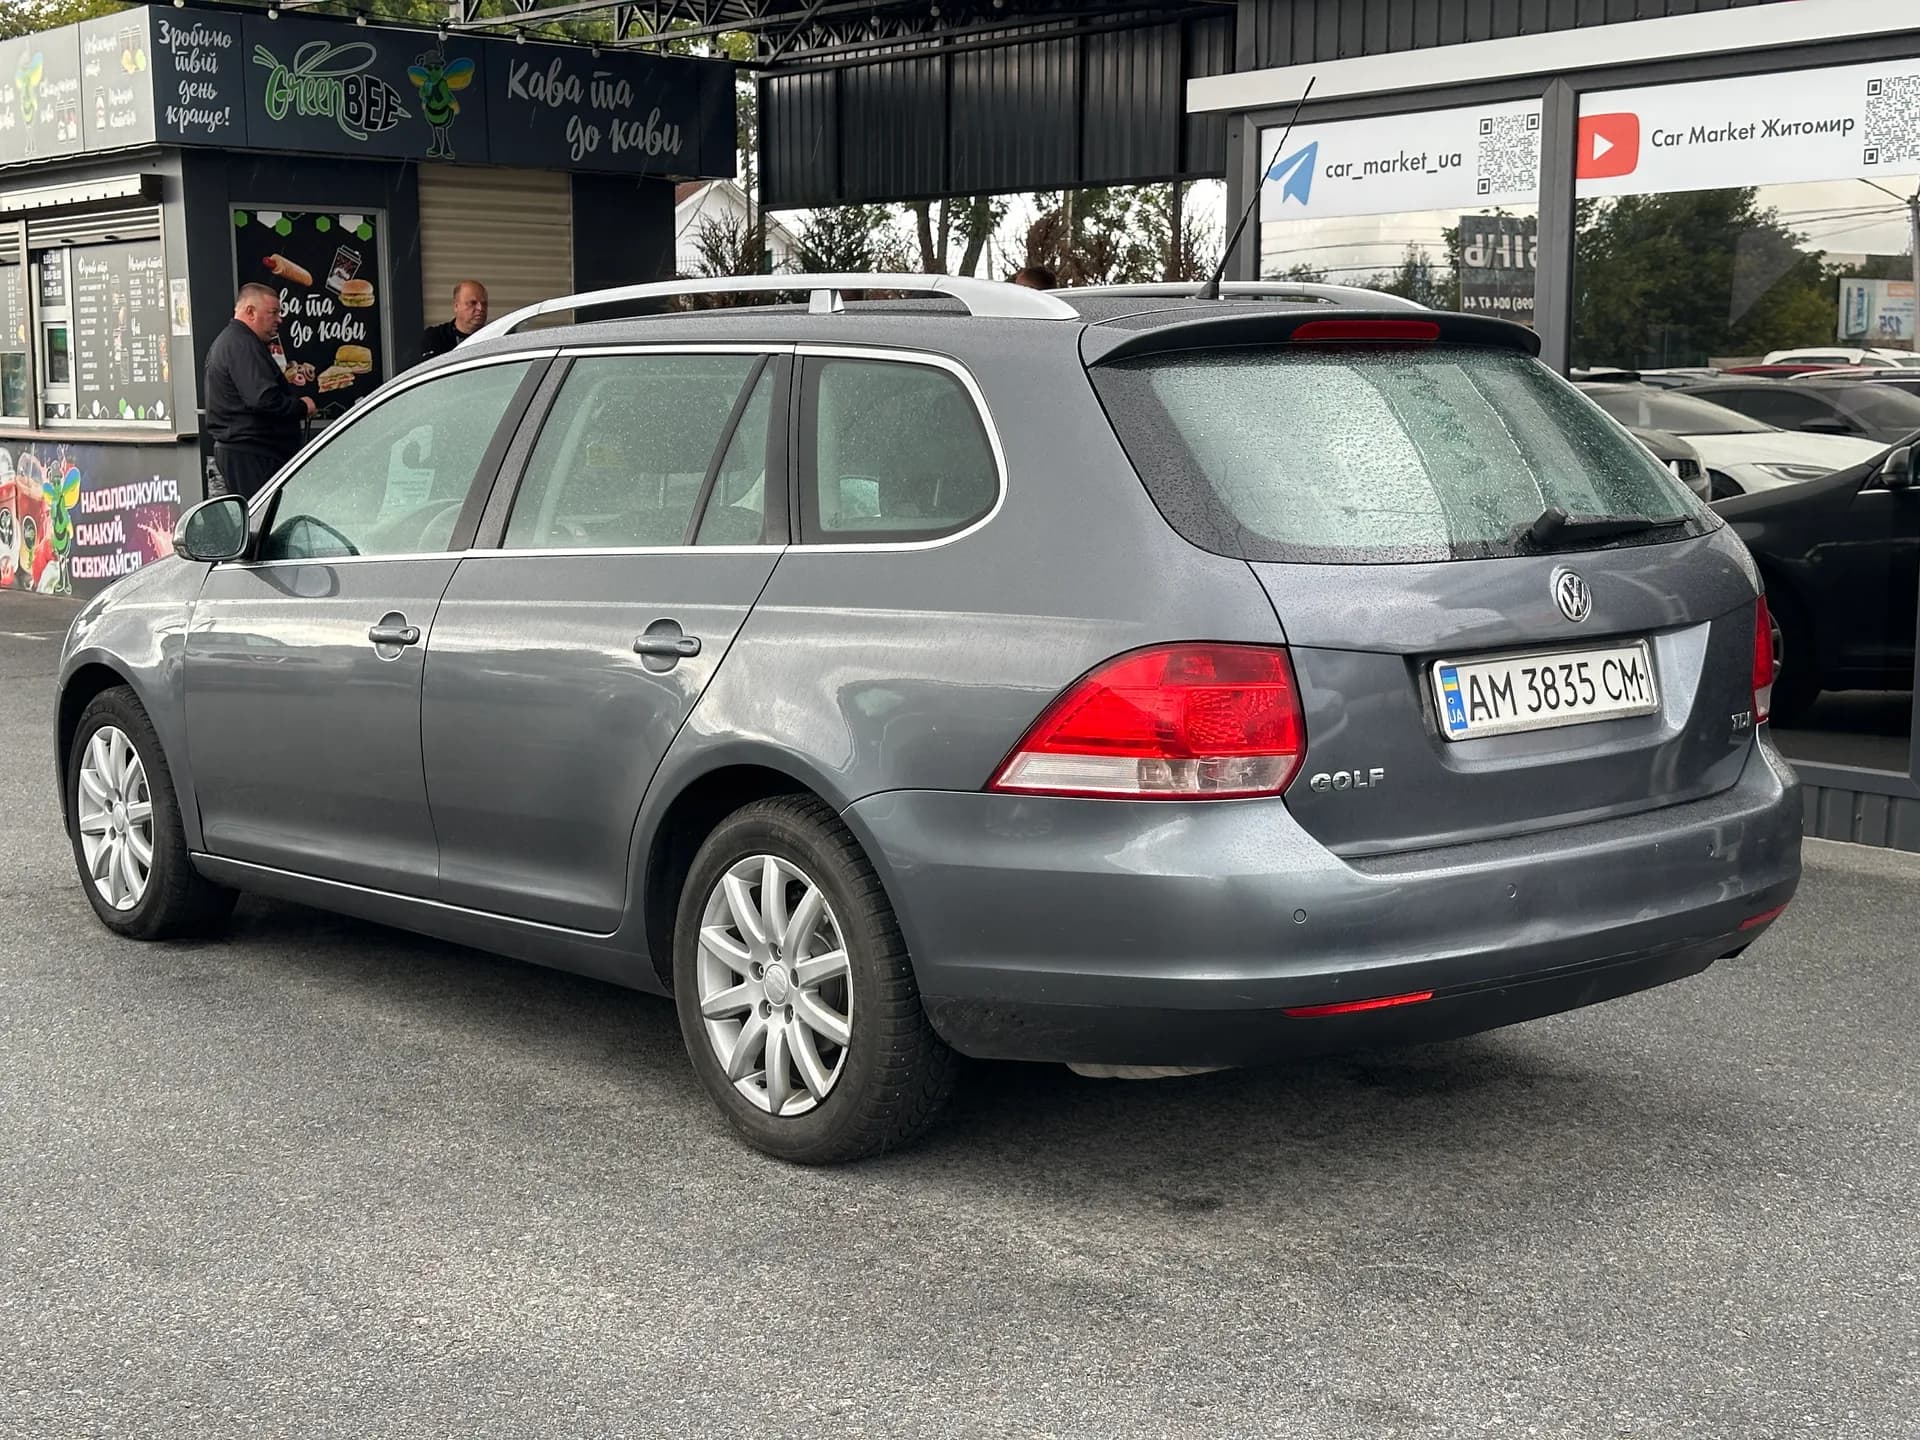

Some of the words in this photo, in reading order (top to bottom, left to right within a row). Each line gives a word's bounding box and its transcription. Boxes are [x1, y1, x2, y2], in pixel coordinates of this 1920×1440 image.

[158, 19, 233, 49] Зробимо
[175, 50, 218, 74] твій
[178, 79, 217, 104] день
[508, 57, 584, 108] Кава
[590, 71, 634, 110] та
[165, 104, 230, 133] краще!
[1760, 114, 1855, 138] Житомир
[566, 114, 601, 161] до
[608, 107, 683, 156] кави
[1652, 128, 1684, 148] Car
[1687, 122, 1756, 145] Market
[1325, 150, 1463, 181] car_market_ua
[306, 294, 335, 318] та
[290, 319, 313, 348] до
[317, 312, 367, 343] кави
[80, 475, 182, 514] НАСОЛОДЖУЙСЯ,
[76, 514, 126, 546] СМАКУЙ,
[72, 548, 142, 578] ОСВІЖАЙСЯ!
[1468, 669, 1518, 722] AM
[1523, 661, 1596, 713] 3835
[1448, 706, 1465, 723] UA
[1309, 768, 1384, 793] GOLF
